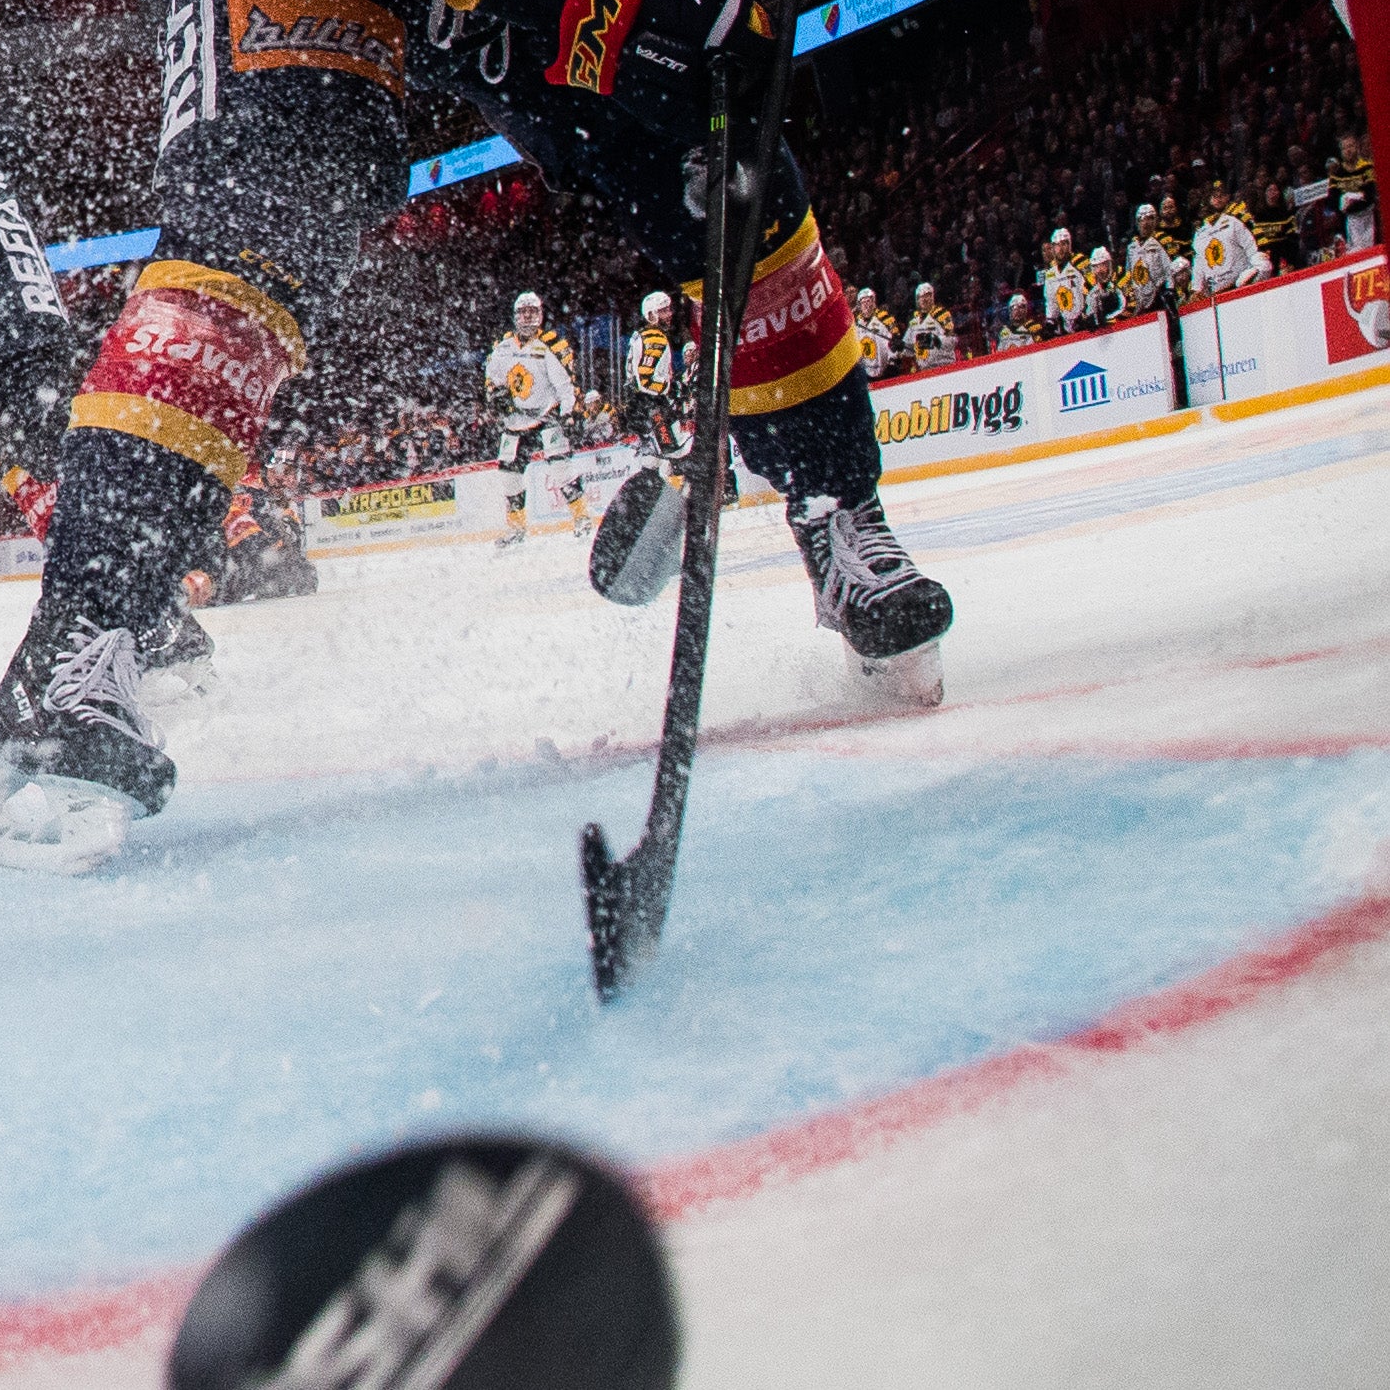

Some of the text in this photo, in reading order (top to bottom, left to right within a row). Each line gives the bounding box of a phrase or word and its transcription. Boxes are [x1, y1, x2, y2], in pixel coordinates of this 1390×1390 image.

[855, 0, 896, 25] Hockey
[737, 266, 834, 346] avdal
[125, 322, 289, 412] Stavdal
